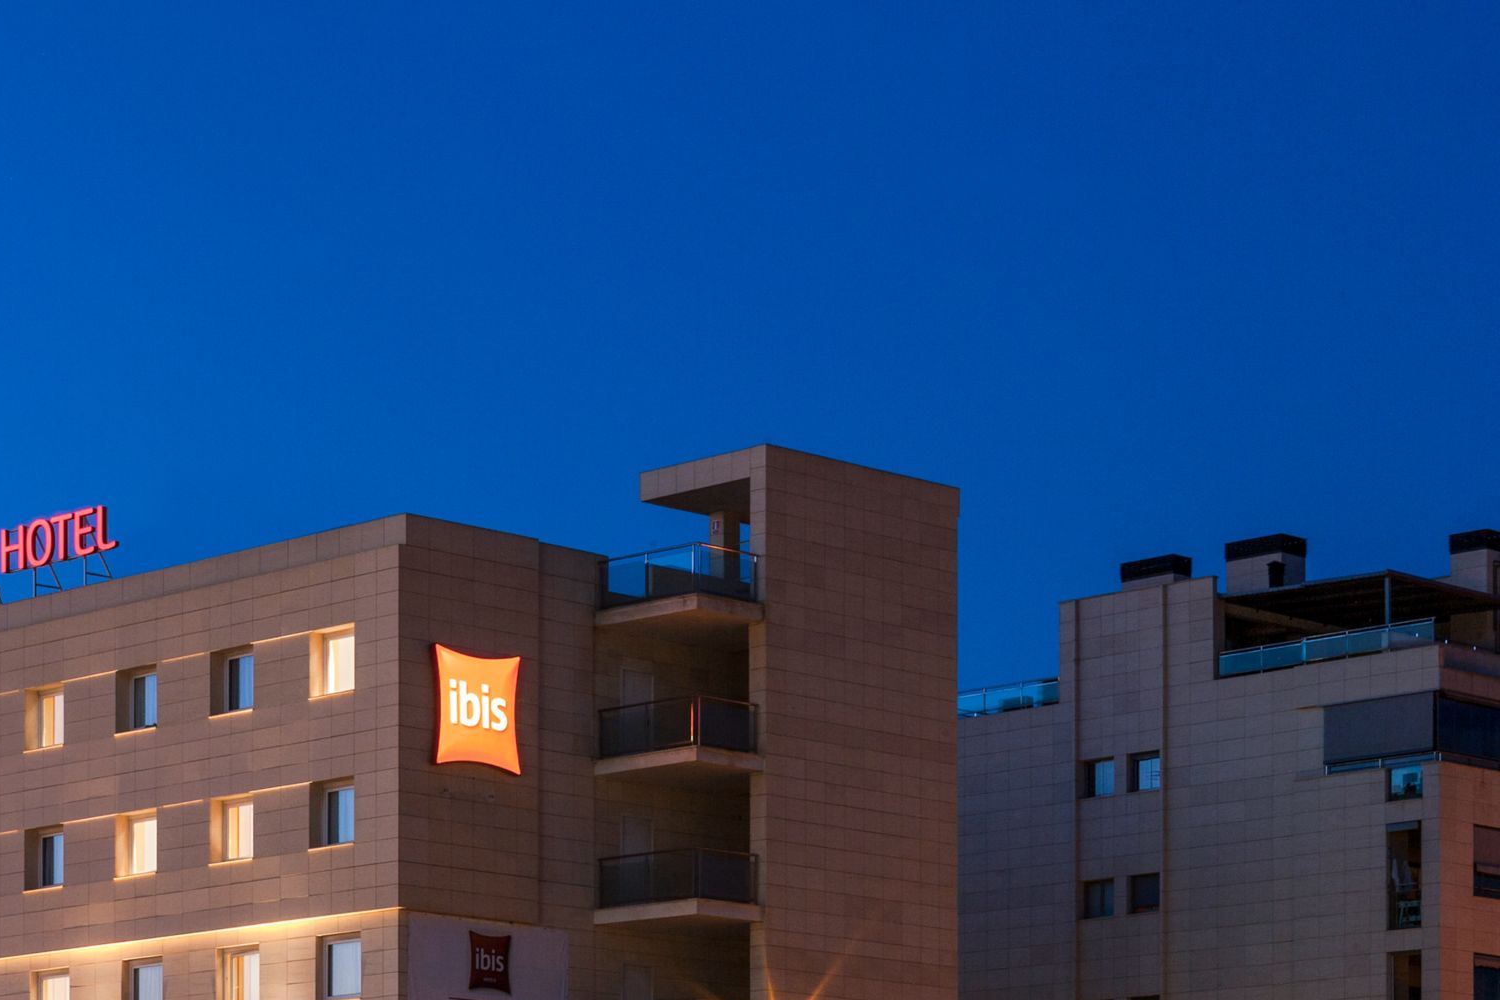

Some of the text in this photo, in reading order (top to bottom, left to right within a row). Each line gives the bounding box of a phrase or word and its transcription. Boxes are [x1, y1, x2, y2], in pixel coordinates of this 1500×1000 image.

[0, 505, 119, 573] HOTEL
[449, 678, 508, 732] ibis
[475, 946, 505, 973] ibis
